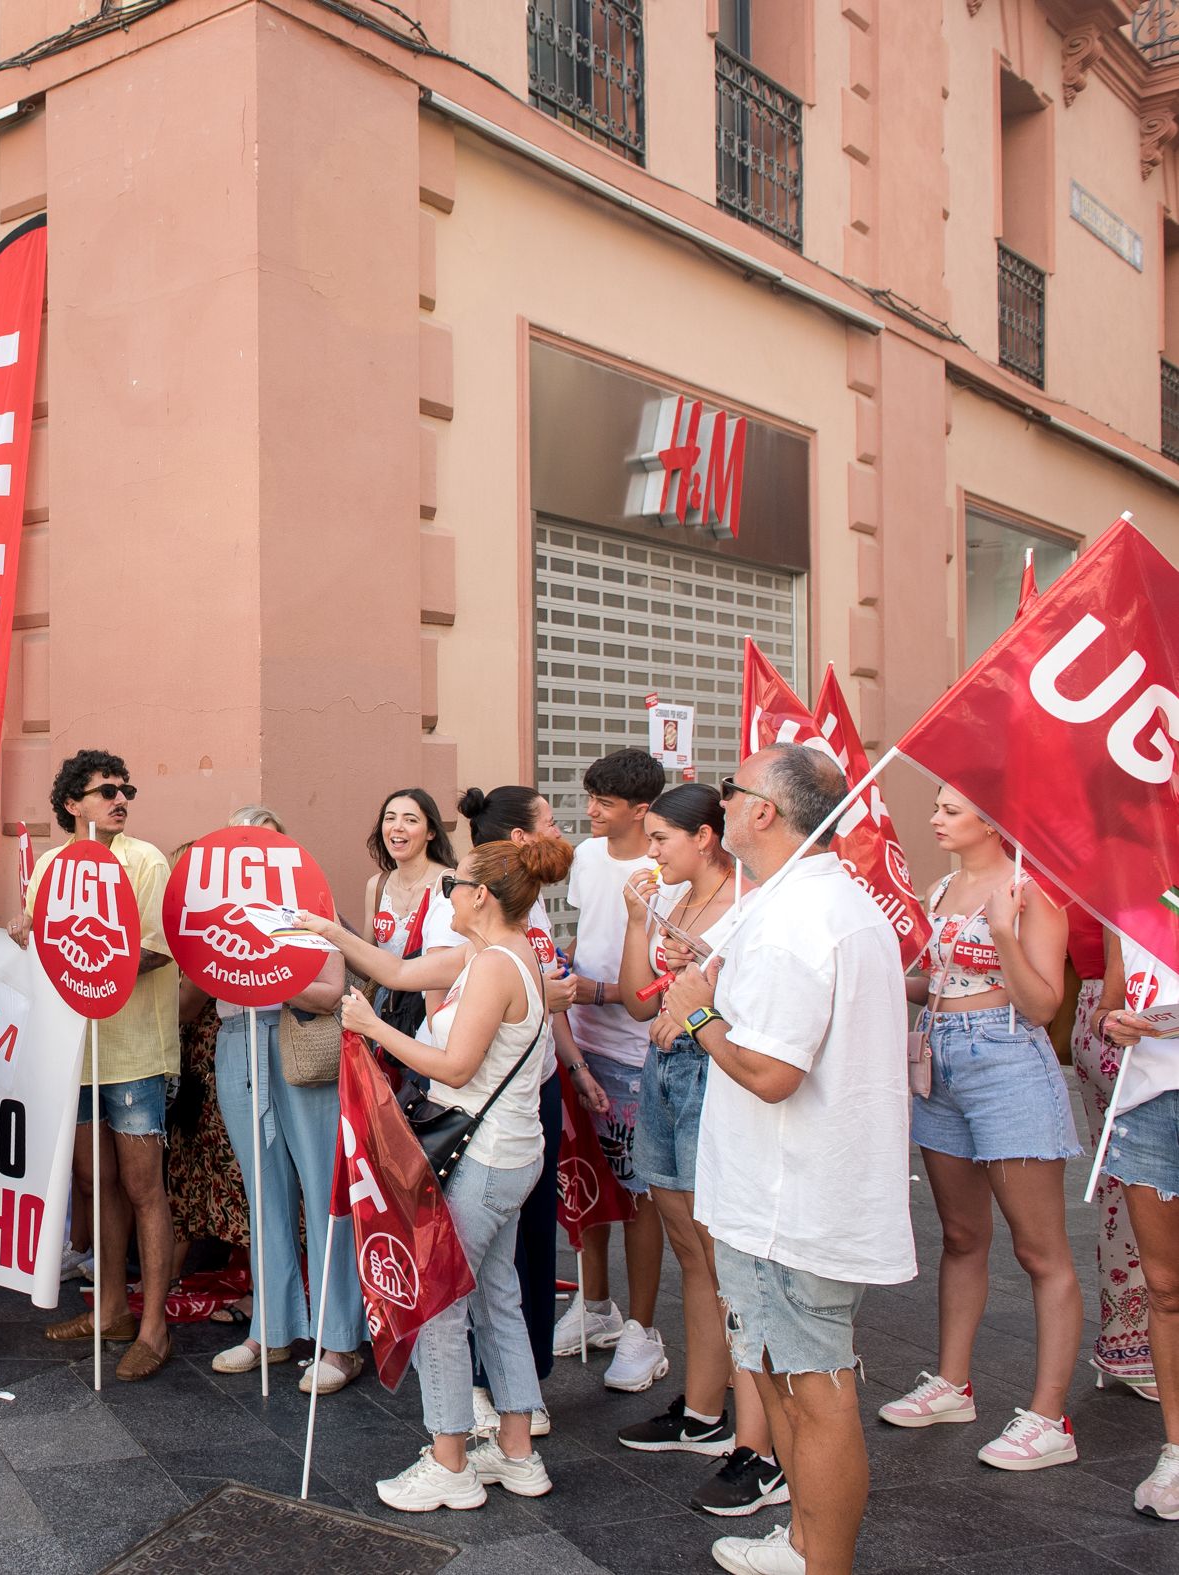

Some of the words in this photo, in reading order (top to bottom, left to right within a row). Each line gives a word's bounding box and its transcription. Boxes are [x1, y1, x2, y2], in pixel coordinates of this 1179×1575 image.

[658, 395, 747, 540] H&M
[47, 857, 121, 925] UGT
[185, 846, 302, 916] UGT
[373, 918, 393, 931] UGT
[956, 945, 992, 958] CCOO
[60, 970, 118, 999] Andalucía
[203, 961, 293, 987] Andalucía
[1143, 1012, 1177, 1023] UGT
